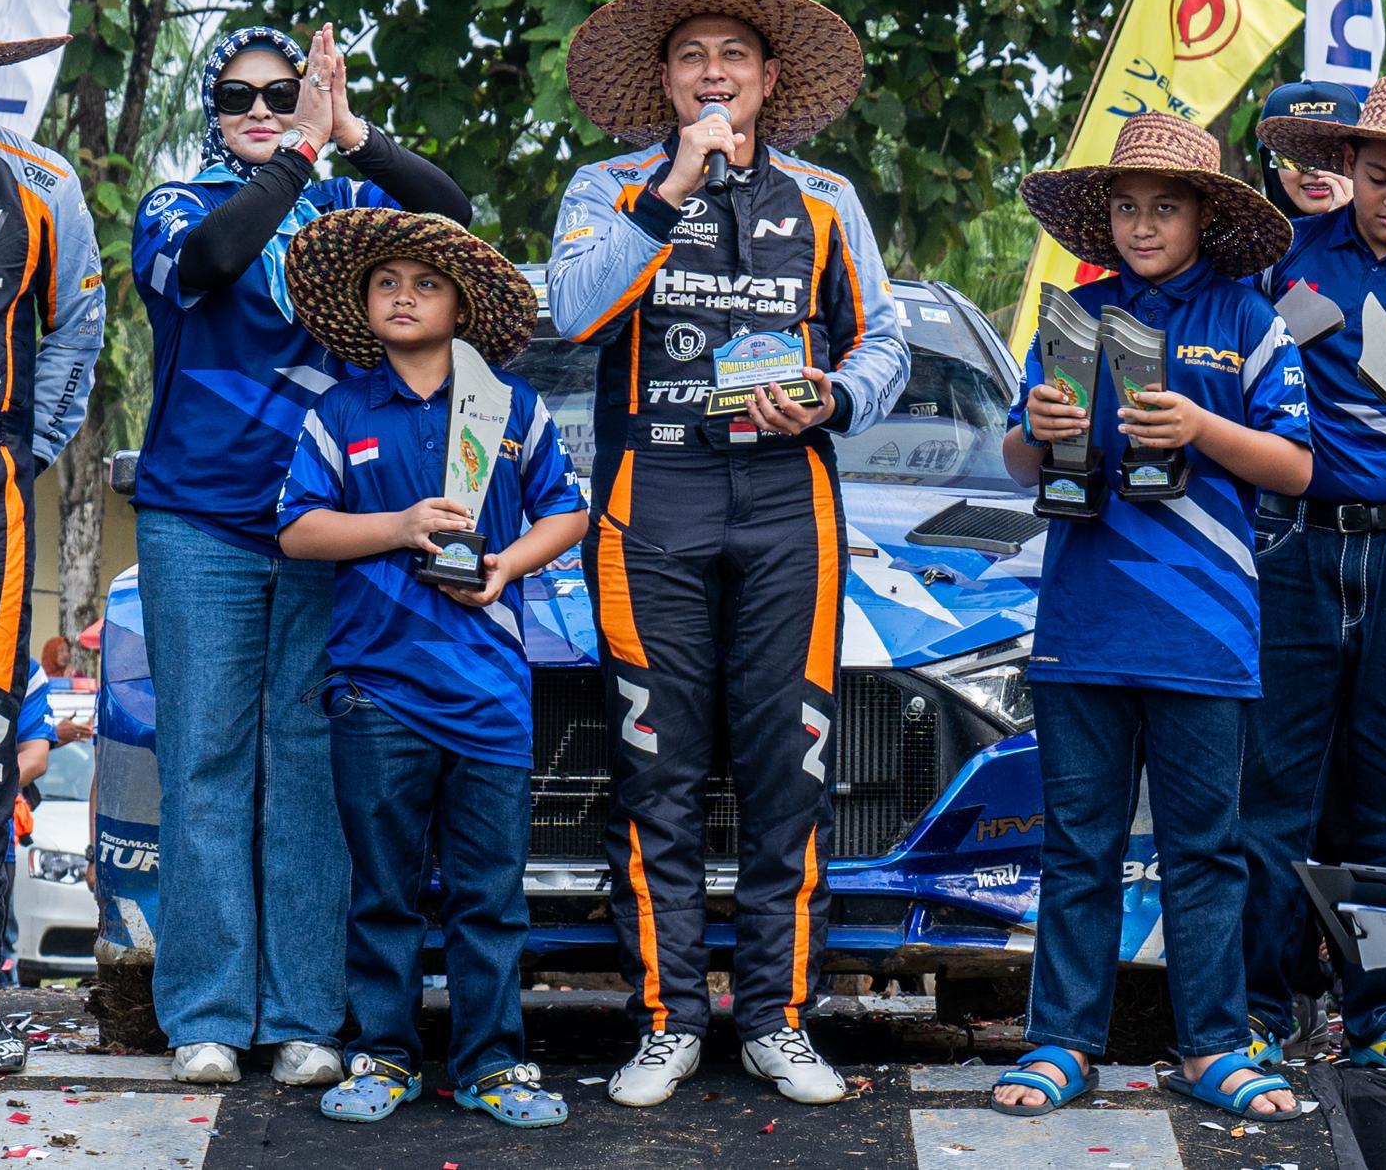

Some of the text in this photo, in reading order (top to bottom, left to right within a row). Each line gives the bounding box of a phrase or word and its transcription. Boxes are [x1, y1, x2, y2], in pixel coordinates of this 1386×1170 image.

[23, 166, 59, 190] OMP
[806, 176, 839, 194] OMP
[654, 270, 802, 303] HRVRT
[718, 349, 801, 376] SUMATERA UTARA RALLY
[650, 426, 685, 442] OMP
[100, 831, 160, 851] PERTAMAX
